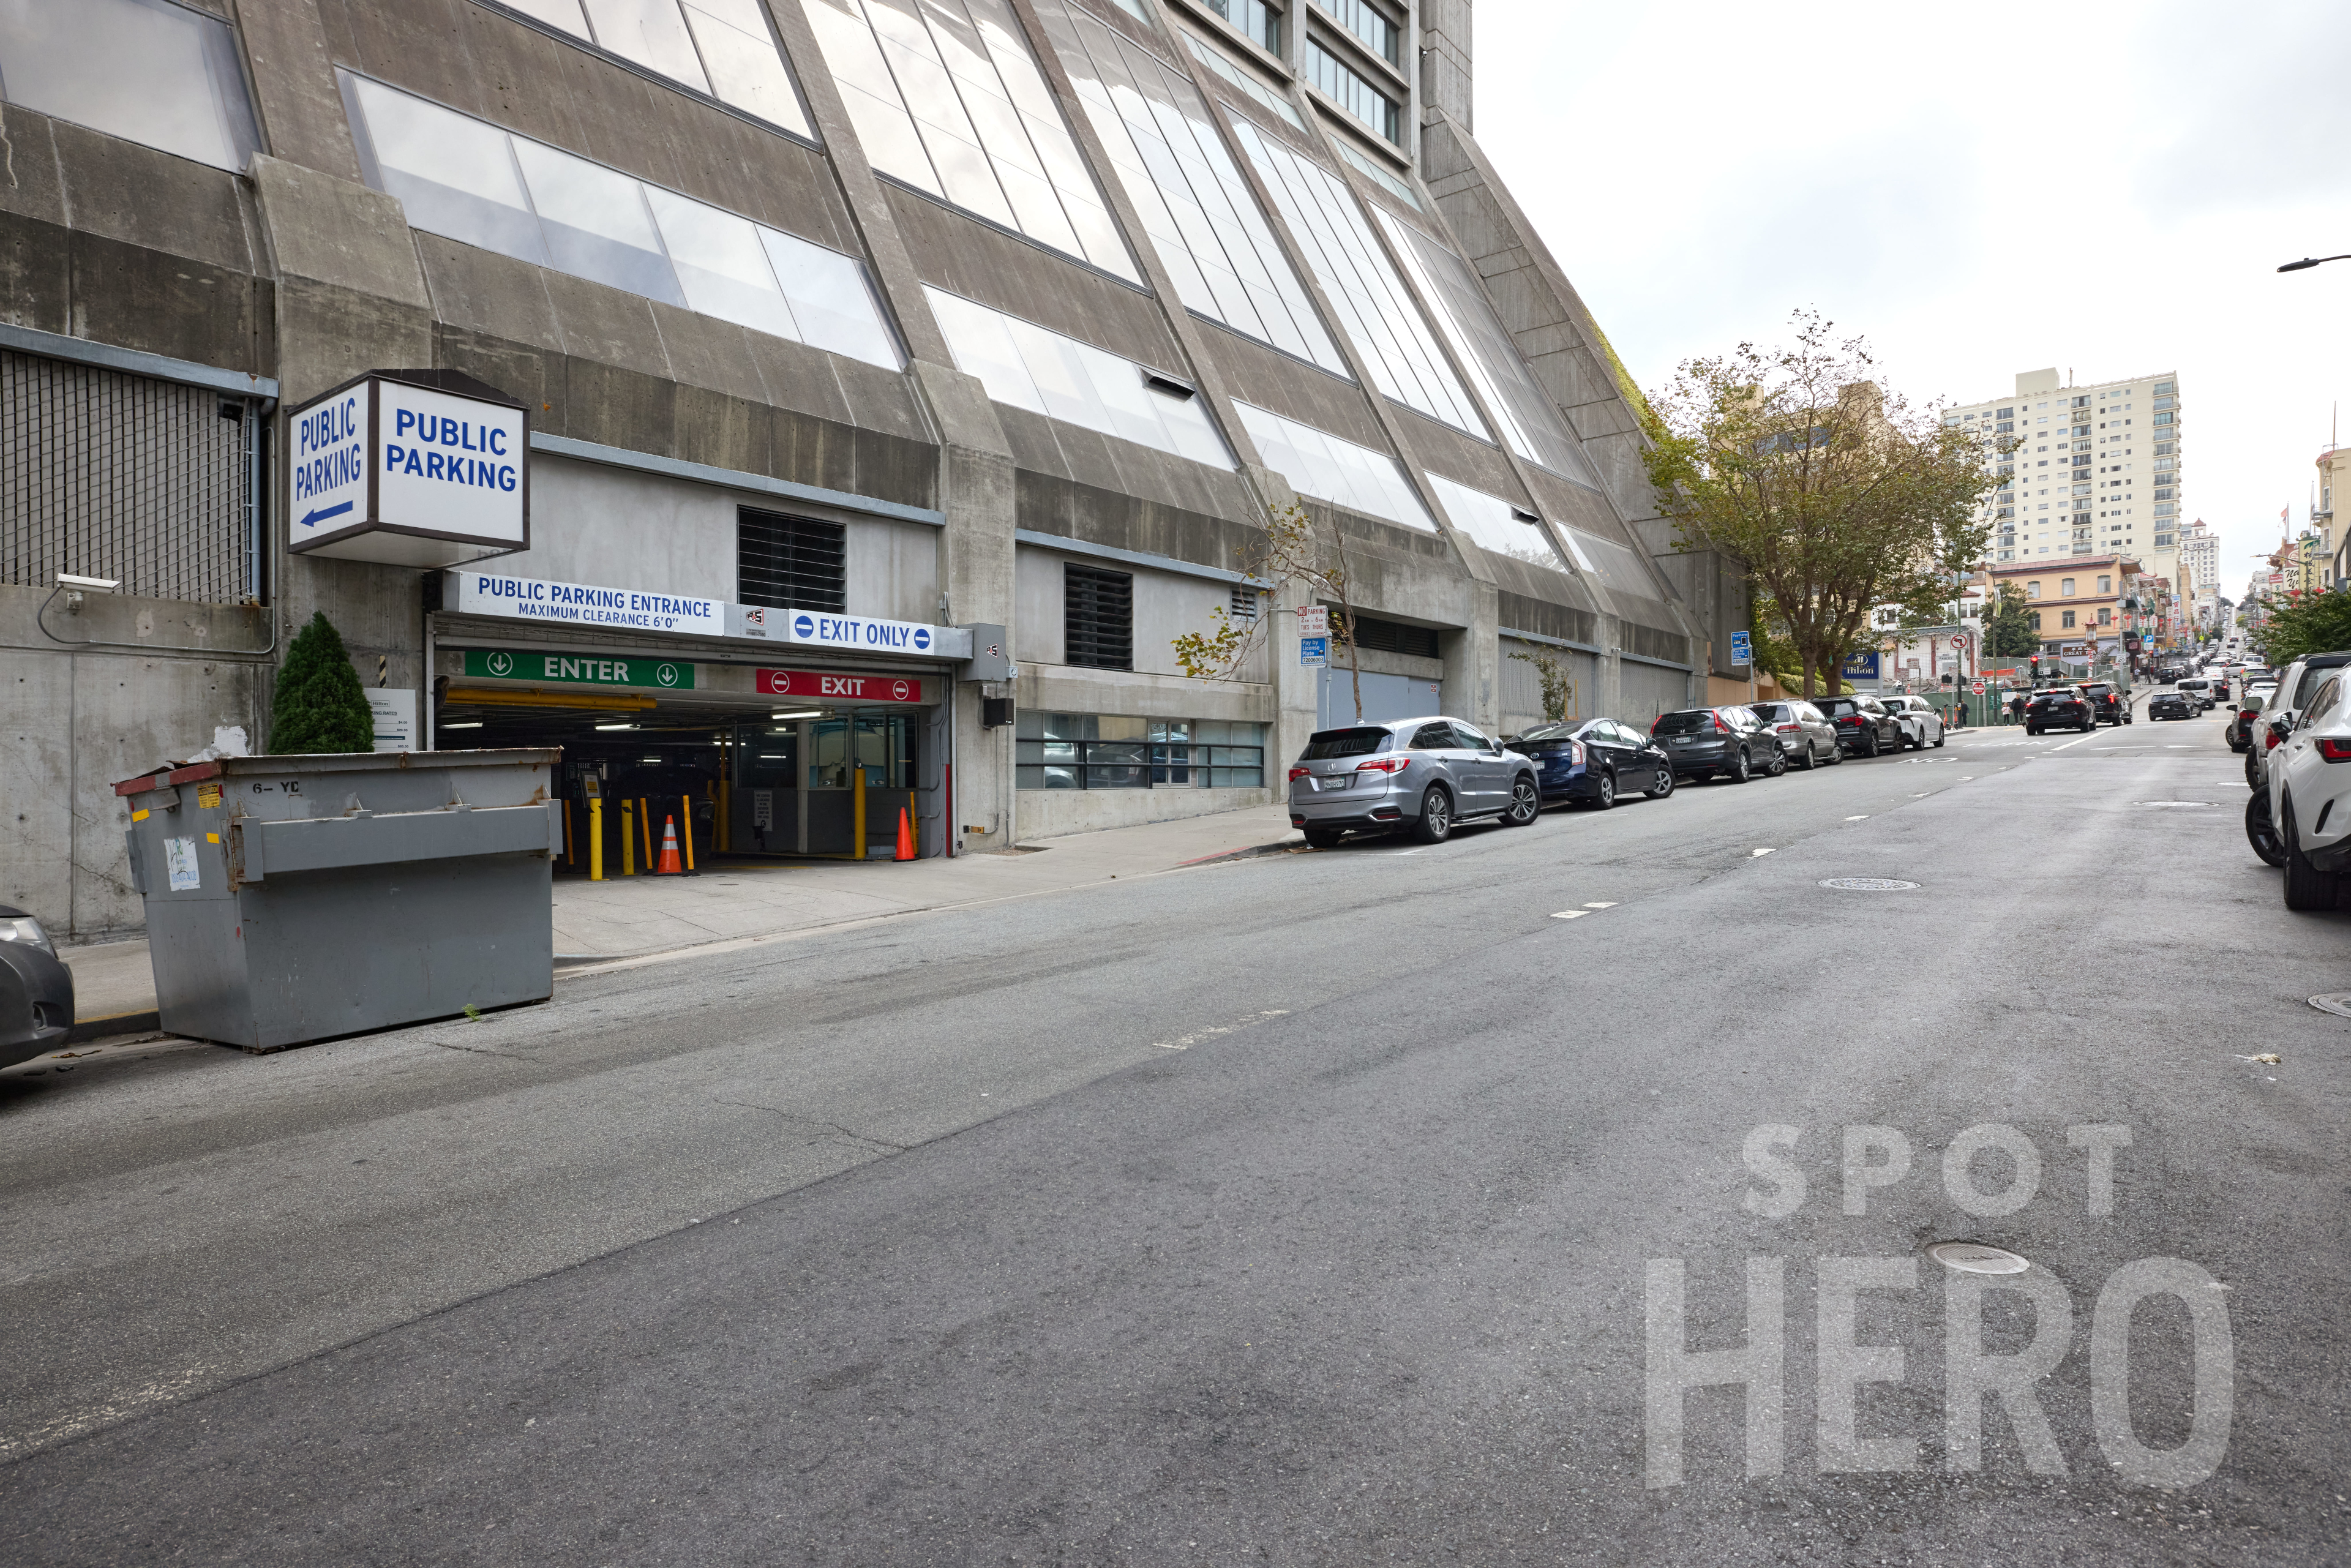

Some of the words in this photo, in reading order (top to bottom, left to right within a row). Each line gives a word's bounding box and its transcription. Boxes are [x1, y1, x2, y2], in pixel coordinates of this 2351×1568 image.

[301, 397, 356, 457] PUBLIC
[397, 408, 507, 456] PUBLIC
[296, 443, 361, 501] PARKING
[387, 444, 516, 492] PARKING
[2285, 569, 2299, 578] Na
[479, 577, 544, 601] PUBLIC
[551, 585, 625, 609] PARKING
[631, 594, 711, 618] ENTRANCE
[1299, 607, 1306, 615] NO
[519, 602, 579, 620] MAXIMUM
[583, 609, 650, 626] CLEARANCE
[820, 618, 860, 642] EXIT
[866, 623, 910, 647] ONLY
[544, 657, 629, 682] ENTER
[1847, 666, 1874, 674] Hilton
[821, 677, 865, 696] EXIT
